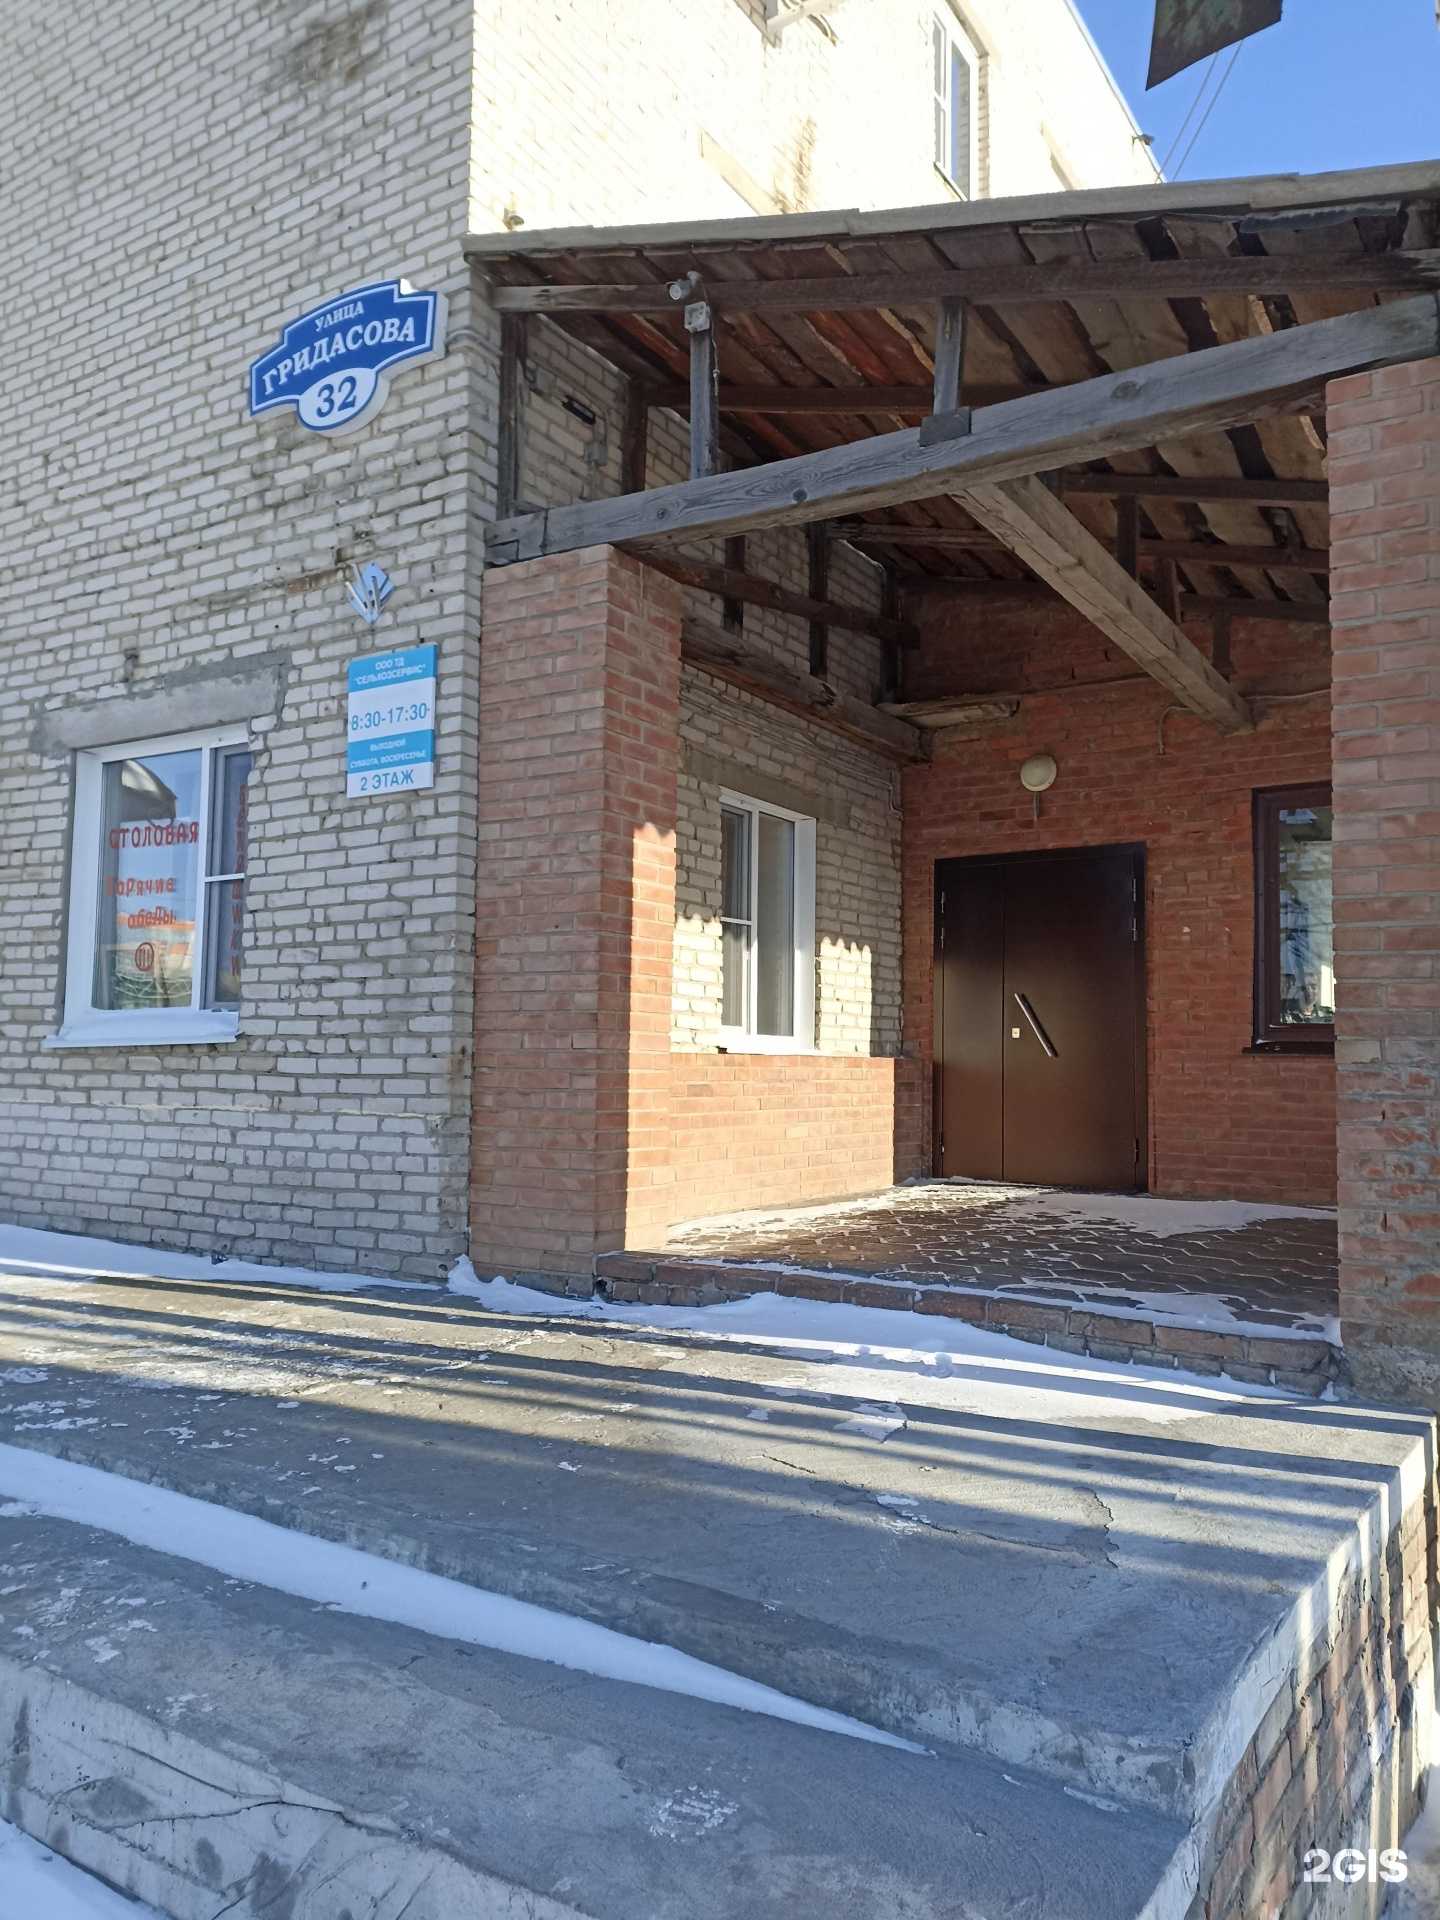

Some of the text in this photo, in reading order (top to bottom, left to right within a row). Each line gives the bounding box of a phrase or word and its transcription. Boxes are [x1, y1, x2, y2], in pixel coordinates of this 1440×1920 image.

[314, 301, 364, 332] УЛИЦА
[262, 316, 415, 395] ГРИДАСОВА
[316, 375, 357, 418] 32
[351, 702, 428, 731] 8:30-17:30
[360, 768, 414, 791] 2 ЭТАЖ
[109, 821, 199, 849] СТОЛОВАЯ
